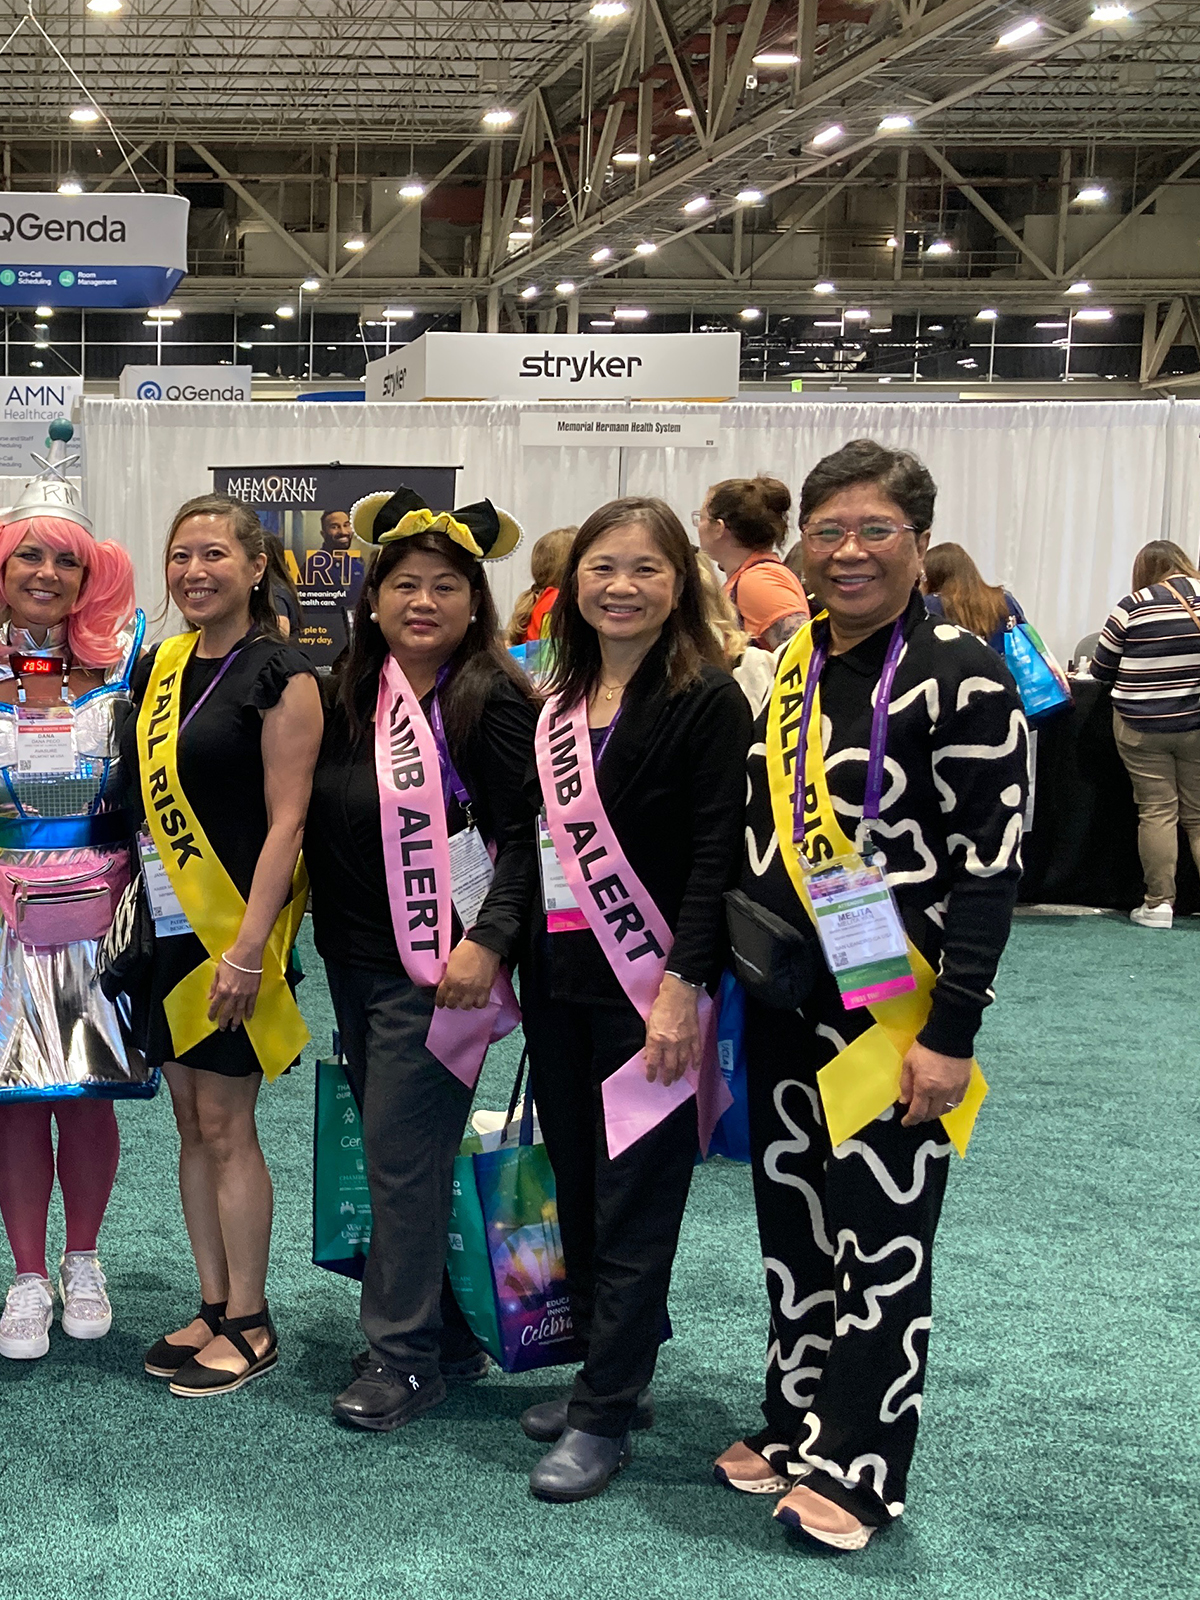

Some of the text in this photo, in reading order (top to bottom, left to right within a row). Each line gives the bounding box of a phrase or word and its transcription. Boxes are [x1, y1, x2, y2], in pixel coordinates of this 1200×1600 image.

[18, 278, 51, 286] Scheduling
[519, 350, 642, 382] stryker
[383, 365, 407, 397] stryker
[5, 386, 64, 406] AMN
[166, 385, 244, 401] QGenda
[4, 409, 64, 420] Healthcare
[557, 421, 681, 434] Memorial Hermann Health System
[227, 476, 317, 491] MEMORIAL
[43, 484, 75, 506] RN
[316, 637, 333, 645] day.
[147, 670, 203, 870] FALL RISK
[779, 662, 834, 866] FALL RIS
[397, 806, 440, 959] ALERT
[563, 820, 666, 962] ALERT
[838, 907, 872, 922] MELITA
[340, 1136, 361, 1148] Cer
[546, 1297, 569, 1308] EDUC
[547, 1306, 570, 1316] INNOV
[521, 1316, 573, 1346] Celebra
